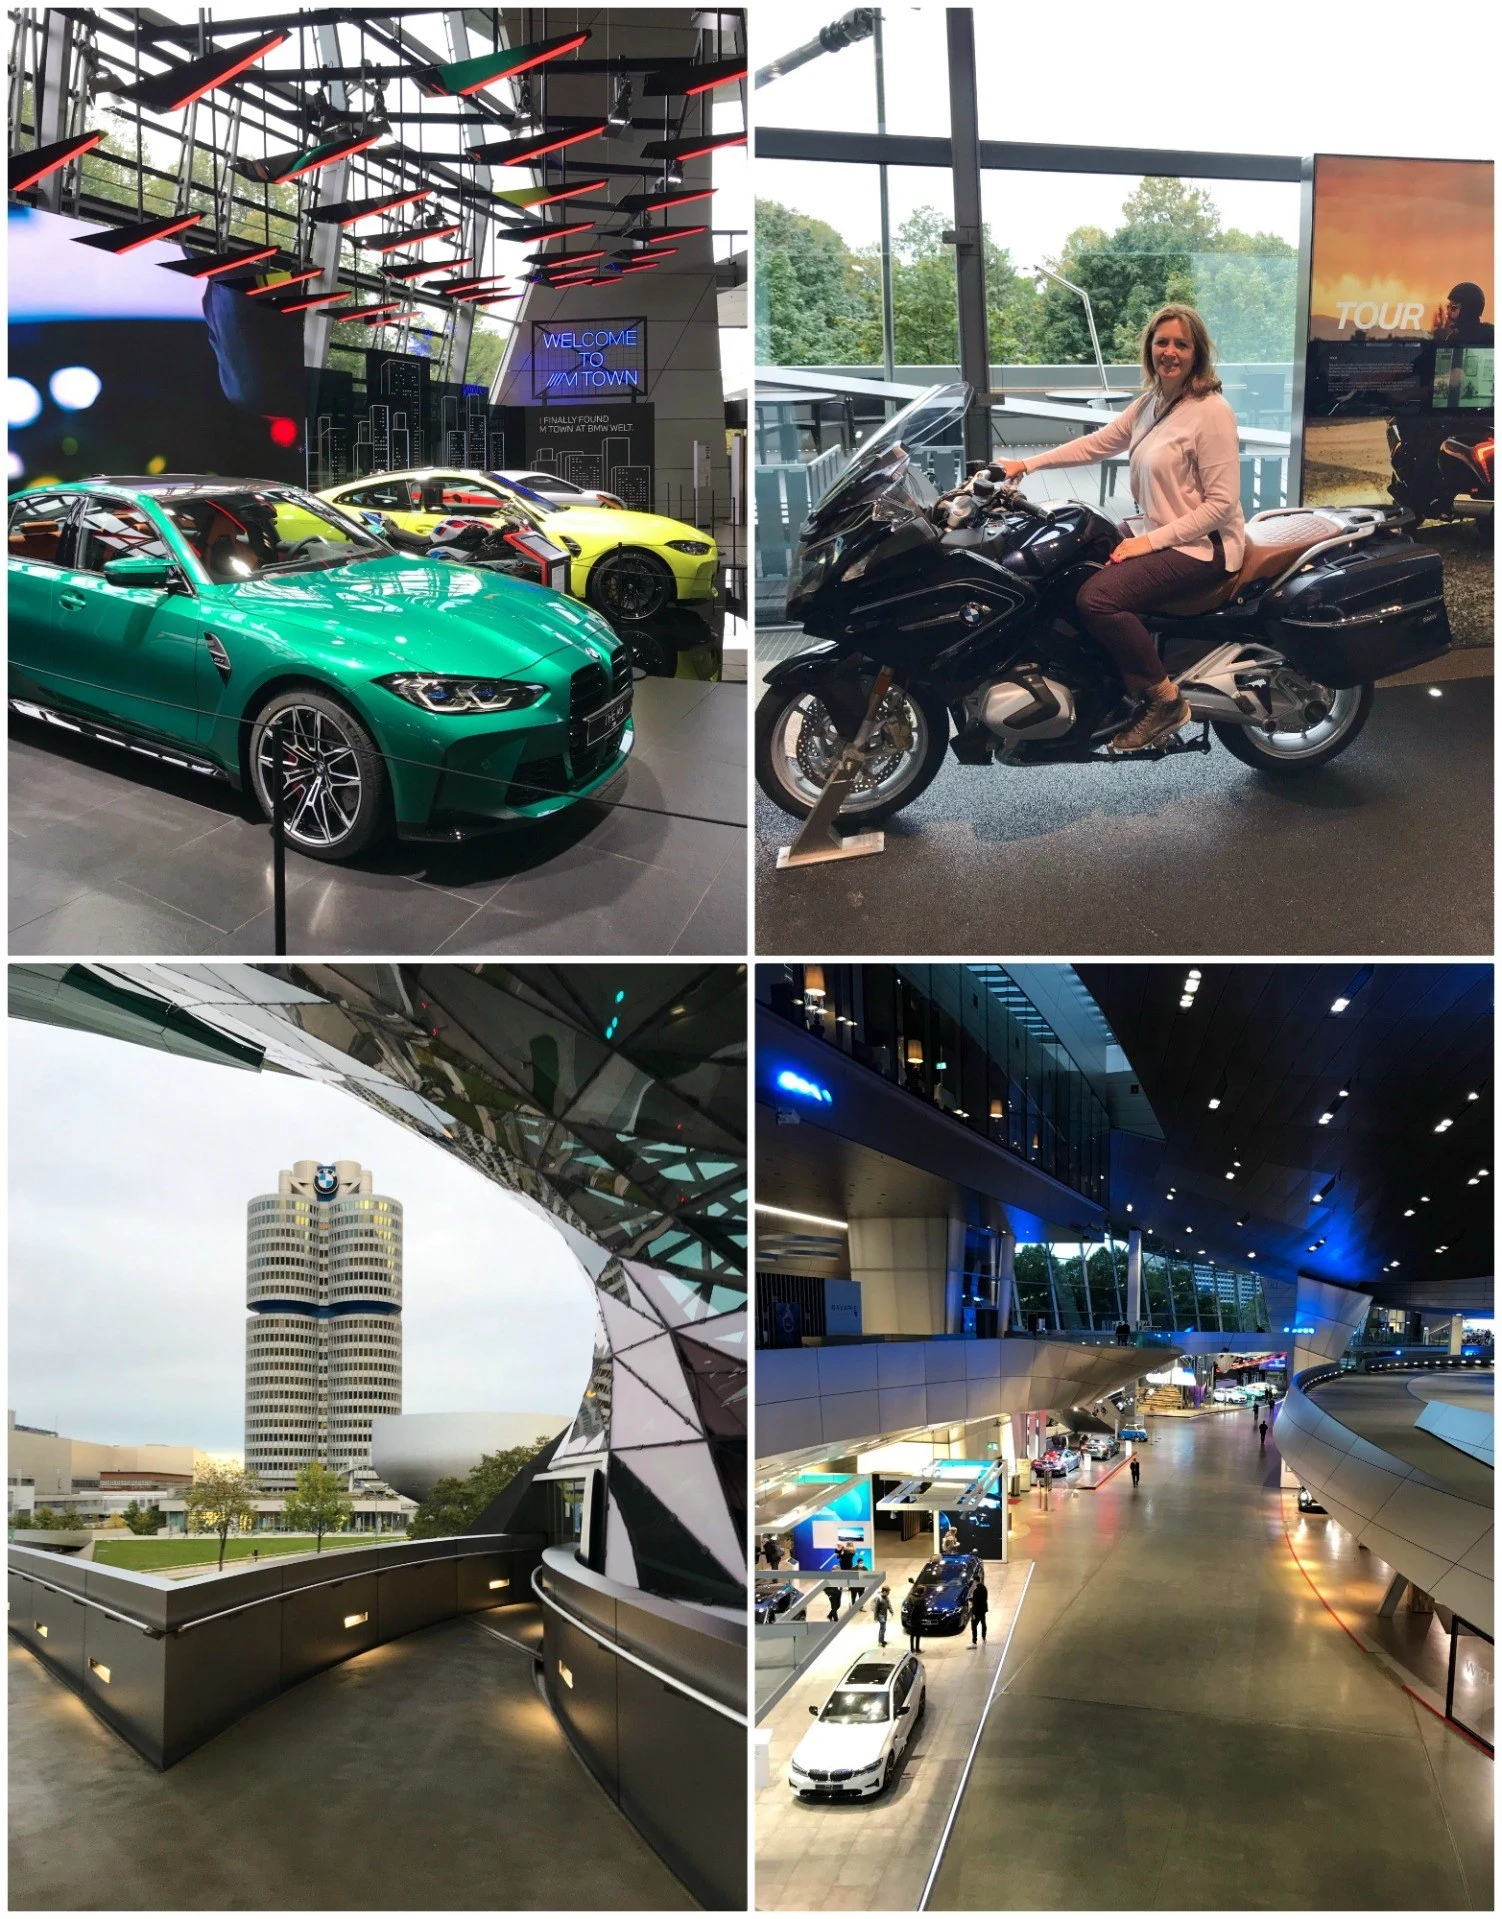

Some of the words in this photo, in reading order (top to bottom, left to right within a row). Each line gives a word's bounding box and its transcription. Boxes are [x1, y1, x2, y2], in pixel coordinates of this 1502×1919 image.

[1336, 301, 1425, 331] TOUR
[542, 330, 637, 349] WELCOME
[579, 352, 603, 367] TO
[581, 370, 638, 387] TOWN
[543, 415, 577, 424] FINALLY
[578, 414, 609, 423] FOUND
[539, 425, 547, 433] M
[548, 425, 574, 433] TOWN
[576, 424, 586, 432] AT
[587, 424, 609, 432] BMW
